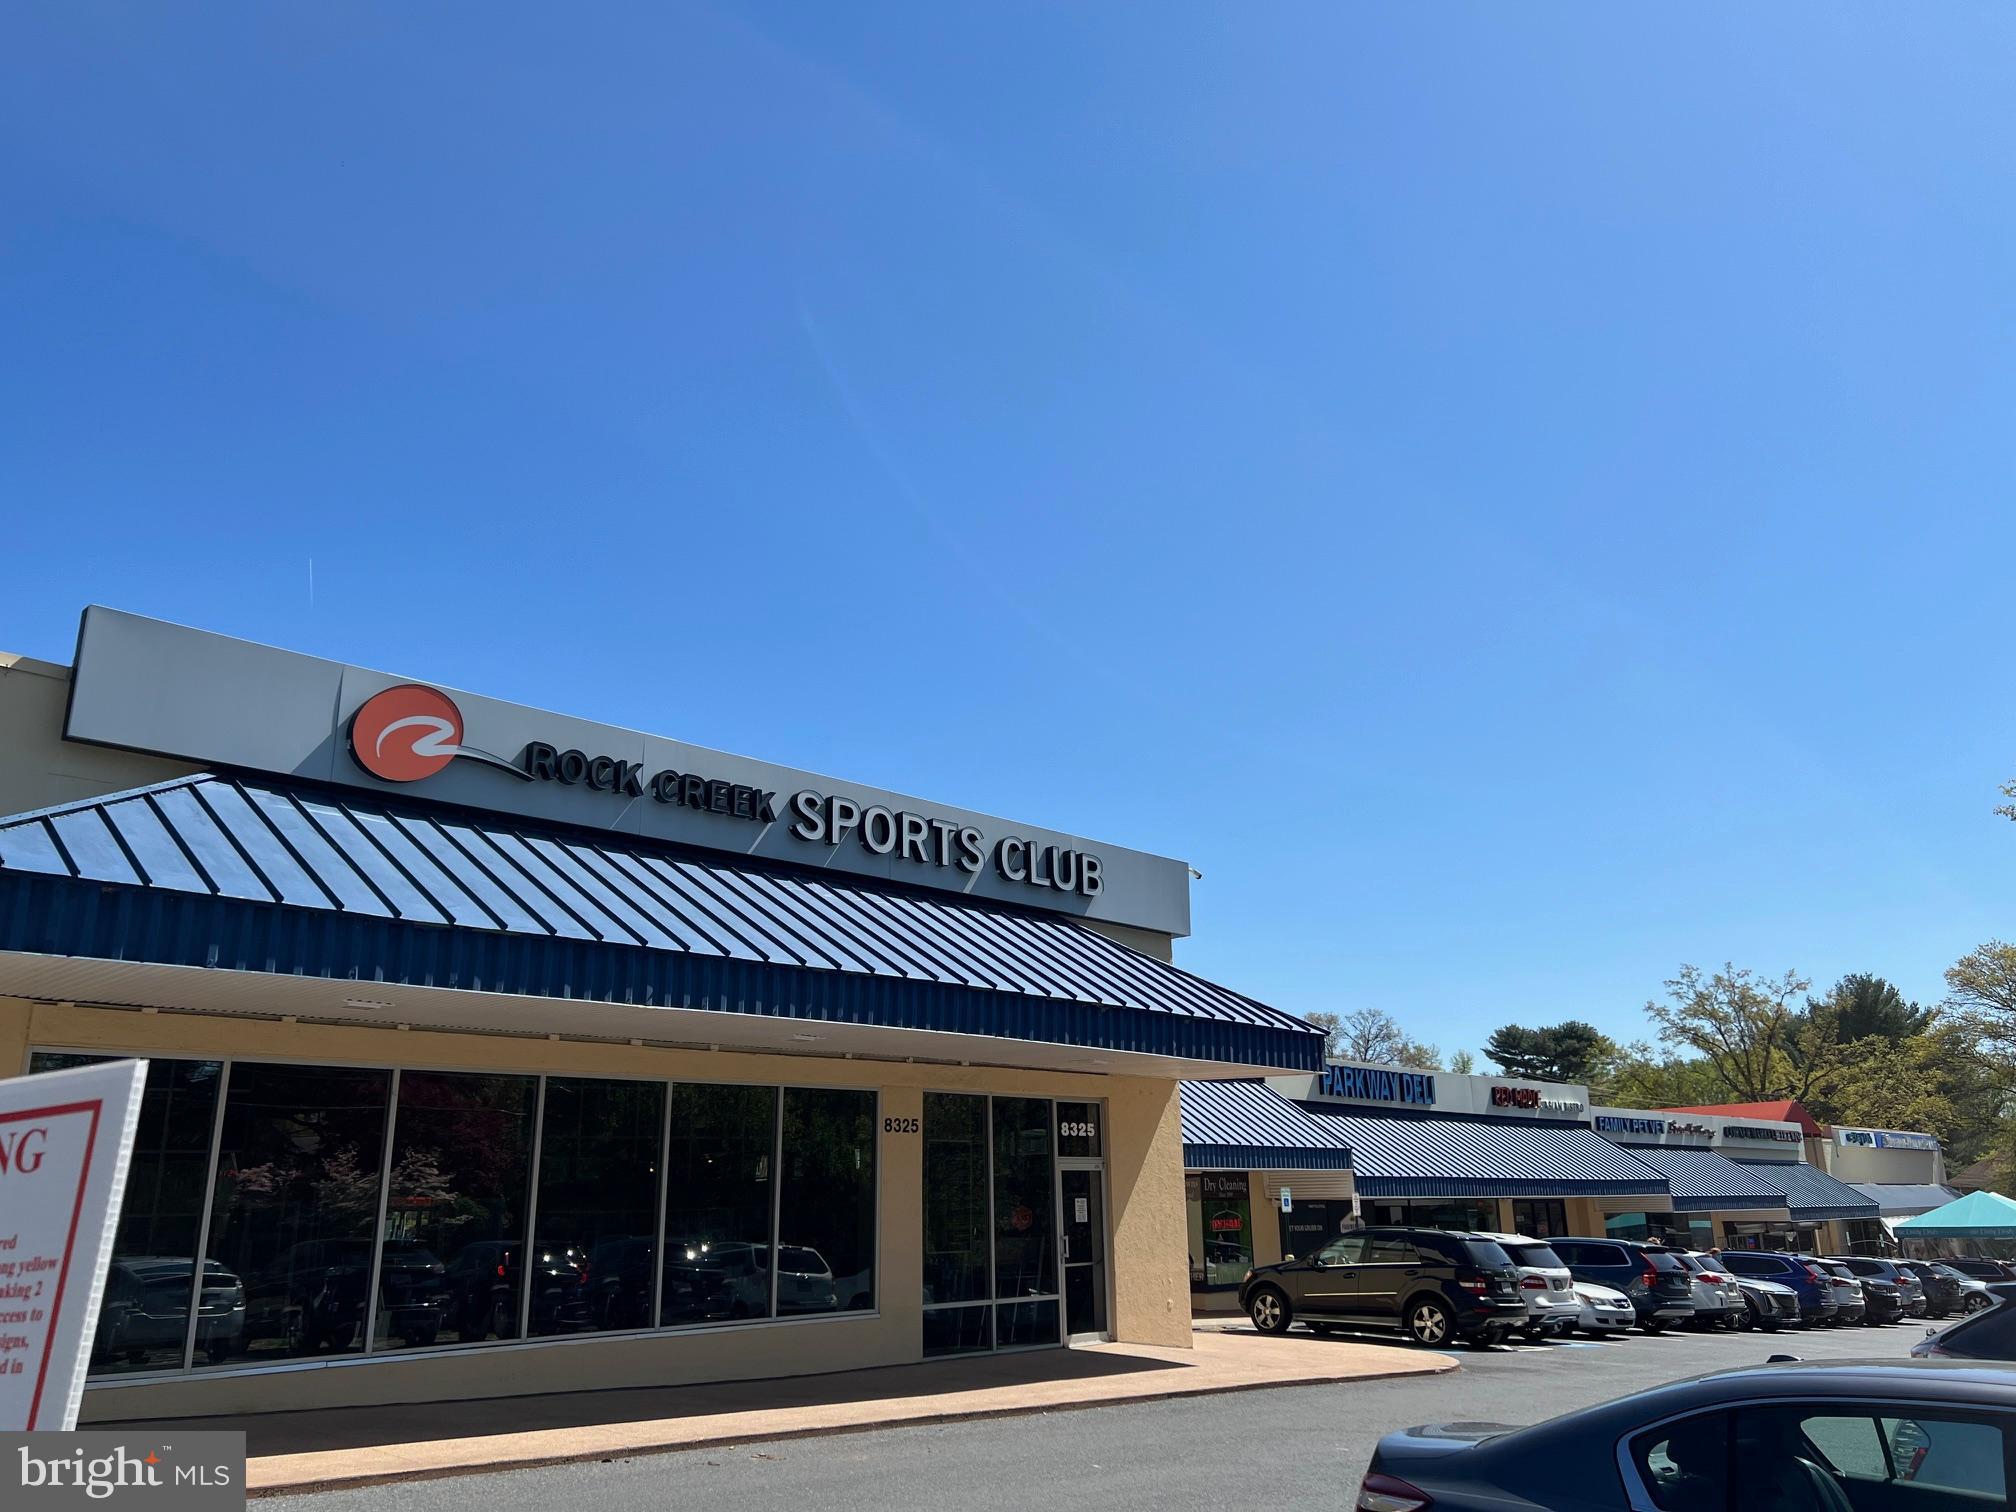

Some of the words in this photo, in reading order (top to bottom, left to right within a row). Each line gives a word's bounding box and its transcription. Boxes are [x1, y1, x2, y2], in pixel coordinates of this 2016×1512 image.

[525, 741, 643, 797] ROCK
[652, 770, 777, 823] CREEK
[790, 789, 985, 873] SPORTS
[996, 836, 1104, 897] CLUB
[1321, 1064, 1398, 1101] PARKWAY
[1400, 1073, 1436, 1104] DELI
[884, 1118, 919, 1133] 8325
[1061, 1122, 1095, 1137] 8325
[1596, 1116, 1630, 1132] FAMILY
[1632, 1118, 1648, 1133] PET
[1649, 1119, 1665, 1134] VET
[1204, 1177, 1217, 1192] Dry
[1218, 1177, 1248, 1193] Cleaning
[17, 1256, 59, 1278] yellow
[35, 1280, 43, 1296] 2
[31, 1307, 44, 1322] to
[11, 1358, 24, 1374] in
